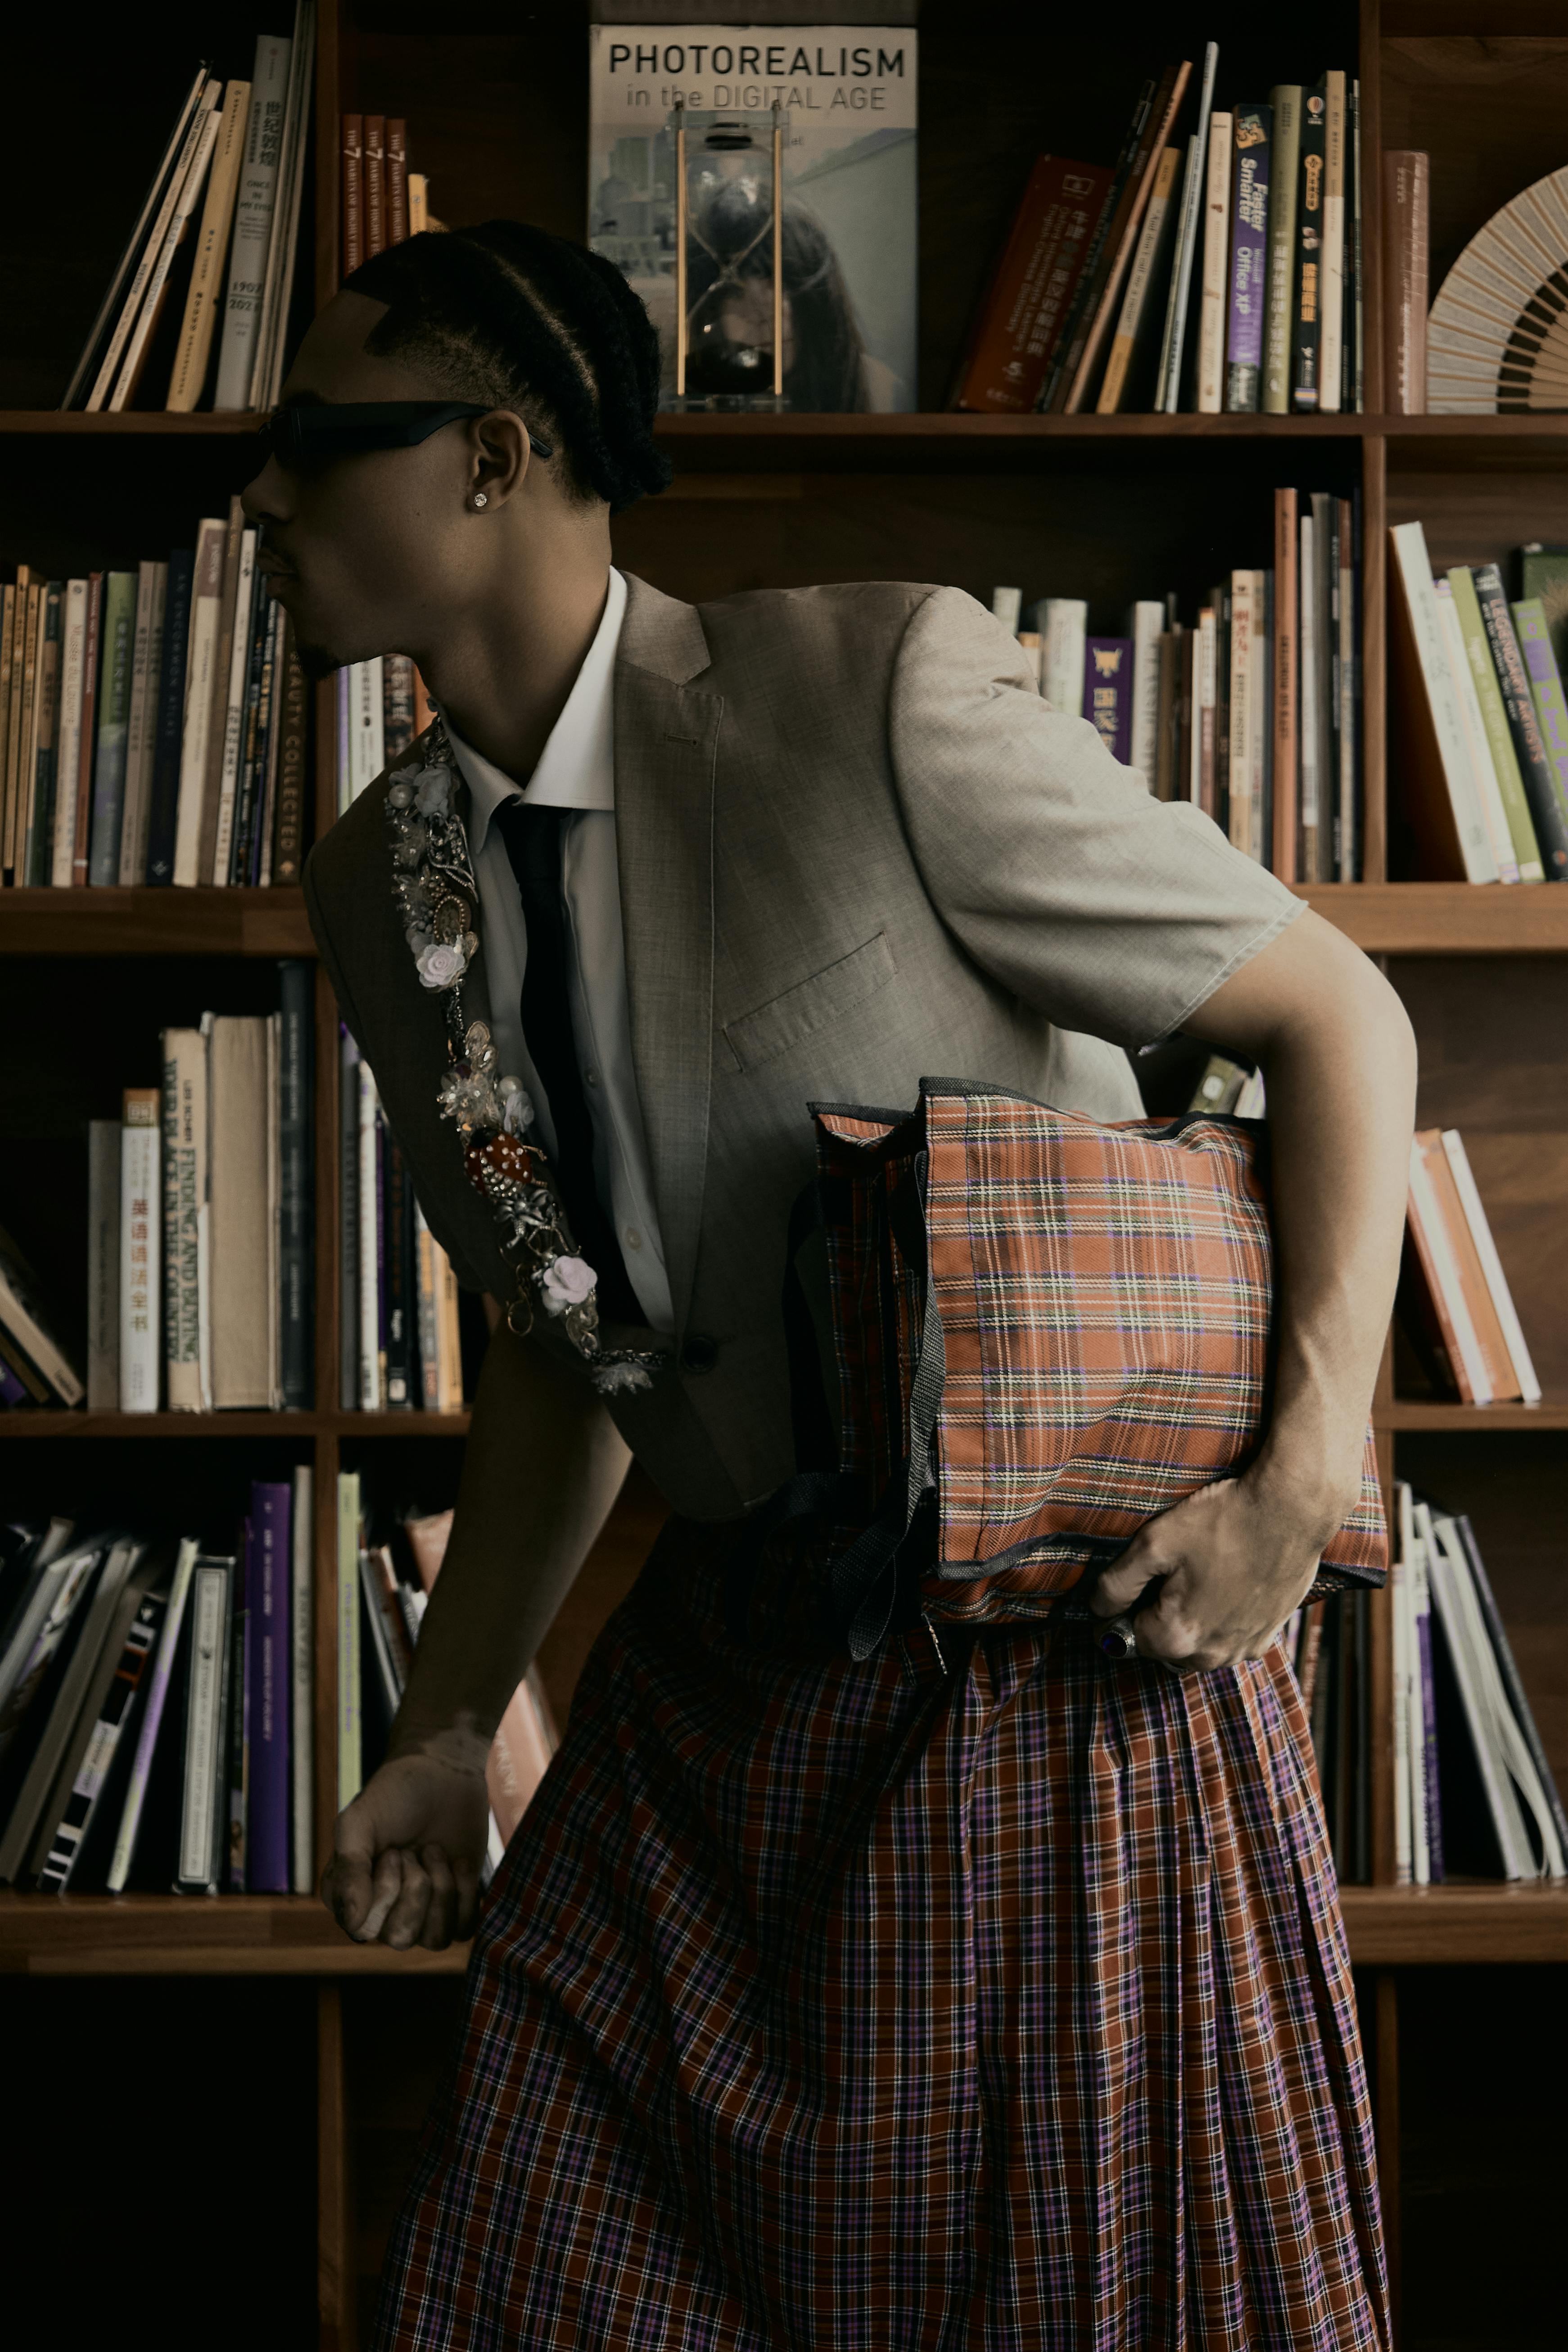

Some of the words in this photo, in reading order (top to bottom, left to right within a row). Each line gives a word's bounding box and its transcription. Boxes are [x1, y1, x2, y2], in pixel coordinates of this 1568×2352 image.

[610, 44, 904, 77] PHOTOREALISM
[626, 85, 650, 107] in
[661, 86, 703, 108] the
[714, 85, 820, 109] DIGITAL
[831, 87, 886, 110] AGE
[343, 147, 361, 159] 7
[347, 130, 357, 147] THE
[365, 148, 384, 159] 7
[369, 131, 379, 148] THE
[391, 134, 401, 150] THE
[387, 151, 405, 162] 7
[347, 160, 357, 192] HABITS
[369, 161, 379, 193] HABITS
[391, 163, 402, 194] HABITS
[1238, 157, 1257, 224] Smarter
[348, 194, 357, 206] OF
[369, 194, 379, 206] OF
[391, 196, 402, 208] OF
[1250, 182, 1268, 232] Faster
[347, 208, 357, 240] HIGHLY
[369, 208, 379, 240] HIGHLY
[1235, 245, 1250, 290] Office
[1234, 292, 1250, 315] XP
[1490, 598, 1527, 695] LEGENDARY
[279, 735, 301, 852] COLLECTED
[164, 1058, 178, 1112] YOUR
[165, 1117, 179, 1188] PLACE
[166, 1192, 180, 1211] IN
[180, 1147, 195, 1233] FINDING
[166, 1219, 180, 1260] THE
[131, 1198, 149, 1332] 英语语法全书
[181, 1239, 197, 1282] AND
[166, 1264, 181, 1361] COUNTRY
[182, 1287, 199, 1363] BUYING
